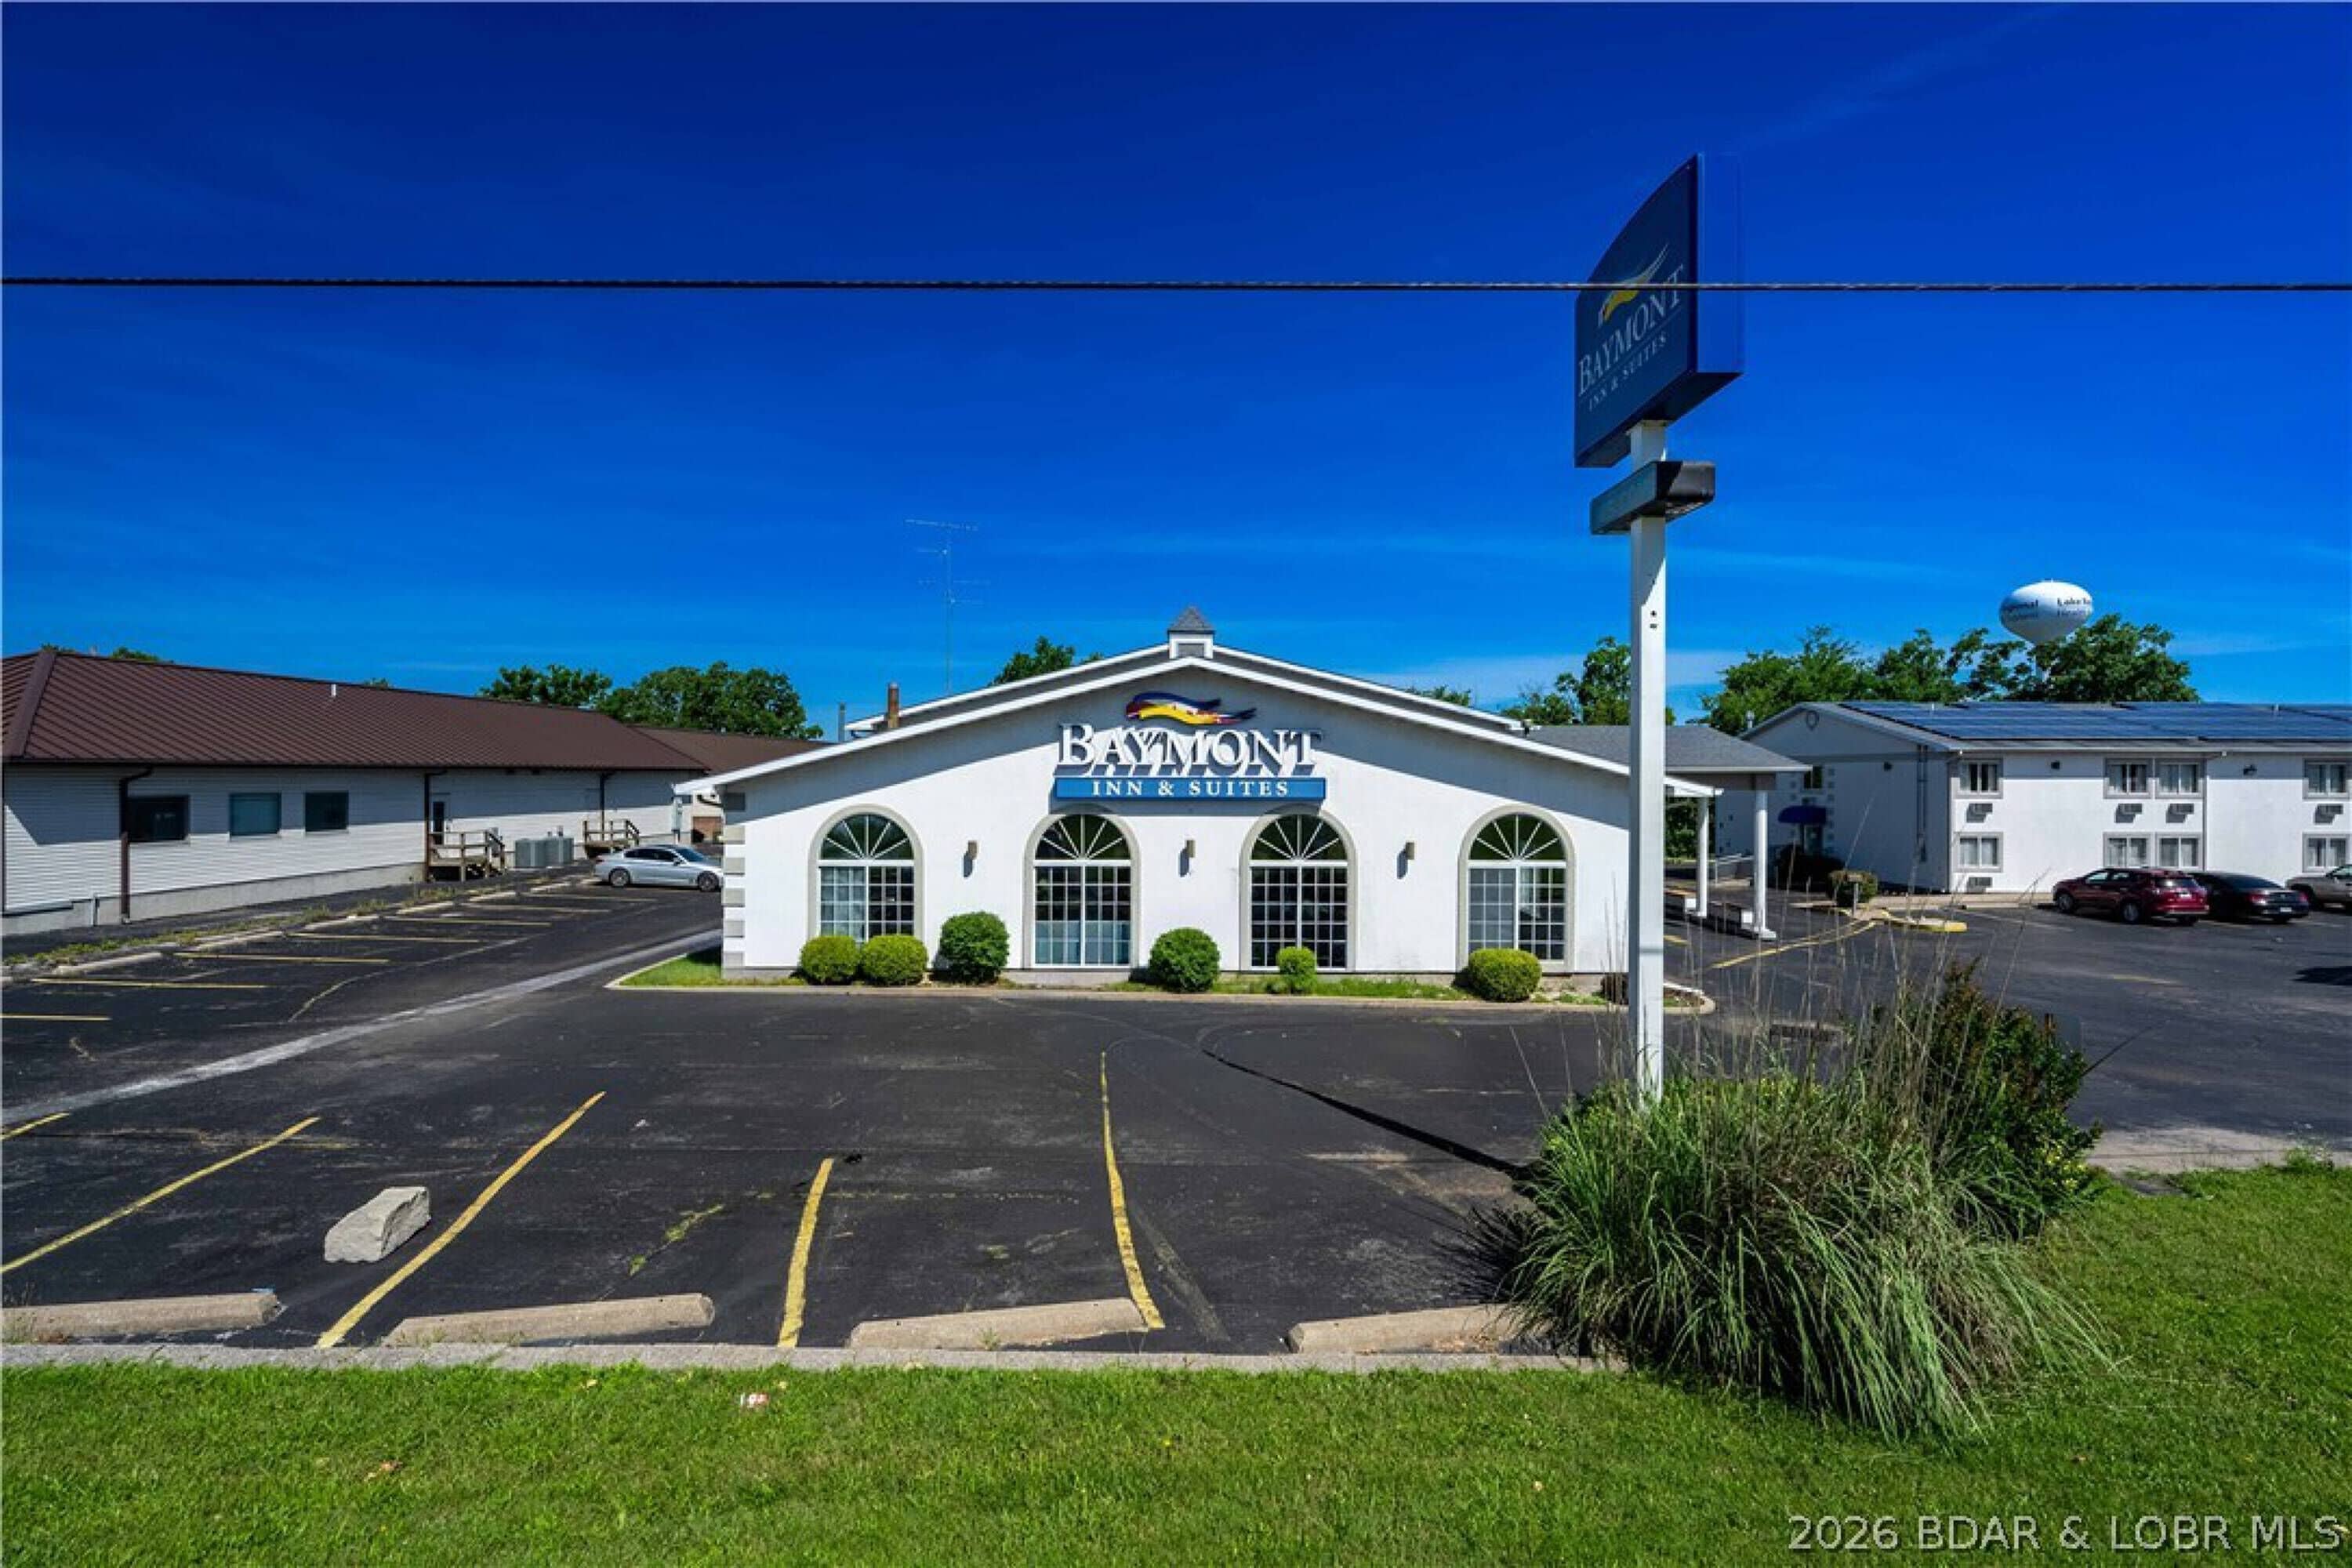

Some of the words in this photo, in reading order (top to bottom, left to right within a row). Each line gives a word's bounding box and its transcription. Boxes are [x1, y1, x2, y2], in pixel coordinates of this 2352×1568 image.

[1578, 263, 1684, 397] BAYMONT
[1588, 387, 1607, 412] INN
[1610, 376, 1619, 391] &
[1622, 330, 1667, 380] SUITES
[1058, 723, 1322, 765] BAYMONT
[1092, 780, 1142, 796] INN
[1158, 780, 1174, 796] &
[1189, 780, 1287, 796] SUITES
